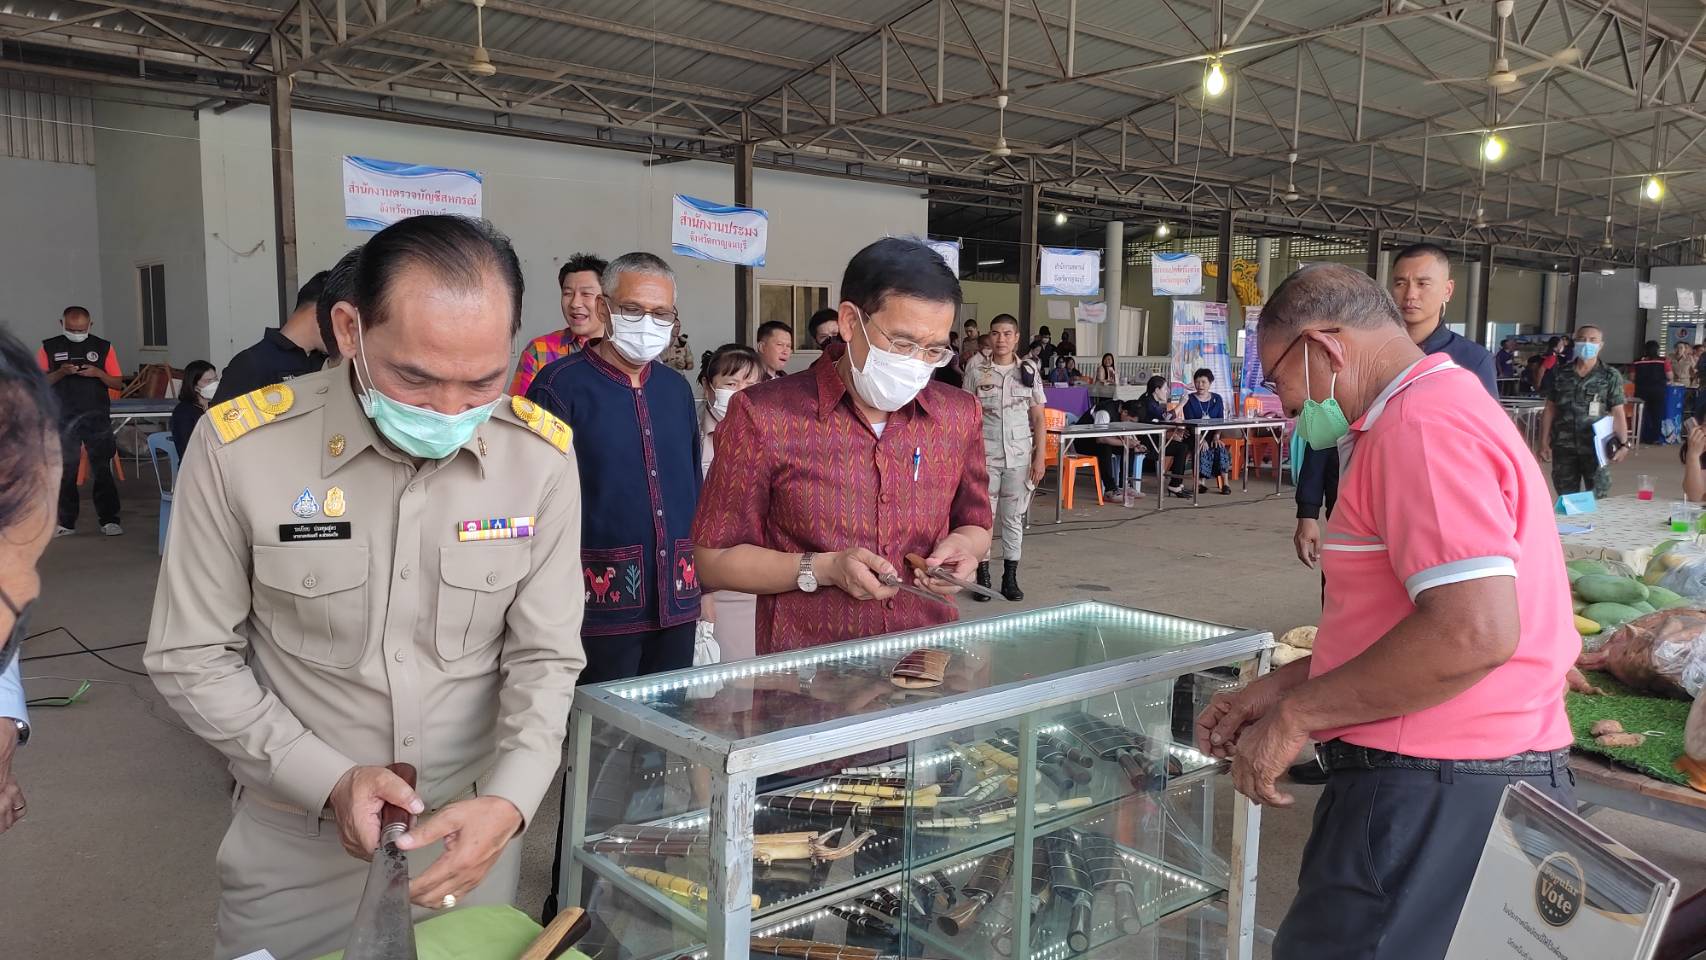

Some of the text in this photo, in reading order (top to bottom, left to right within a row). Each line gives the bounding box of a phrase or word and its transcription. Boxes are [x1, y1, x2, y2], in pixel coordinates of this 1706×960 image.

[680, 211, 759, 237] สำนักงานประมง
[689, 230, 748, 252] จังหวัดกาญจนบุรี
[1541, 879, 1573, 914] Vote
